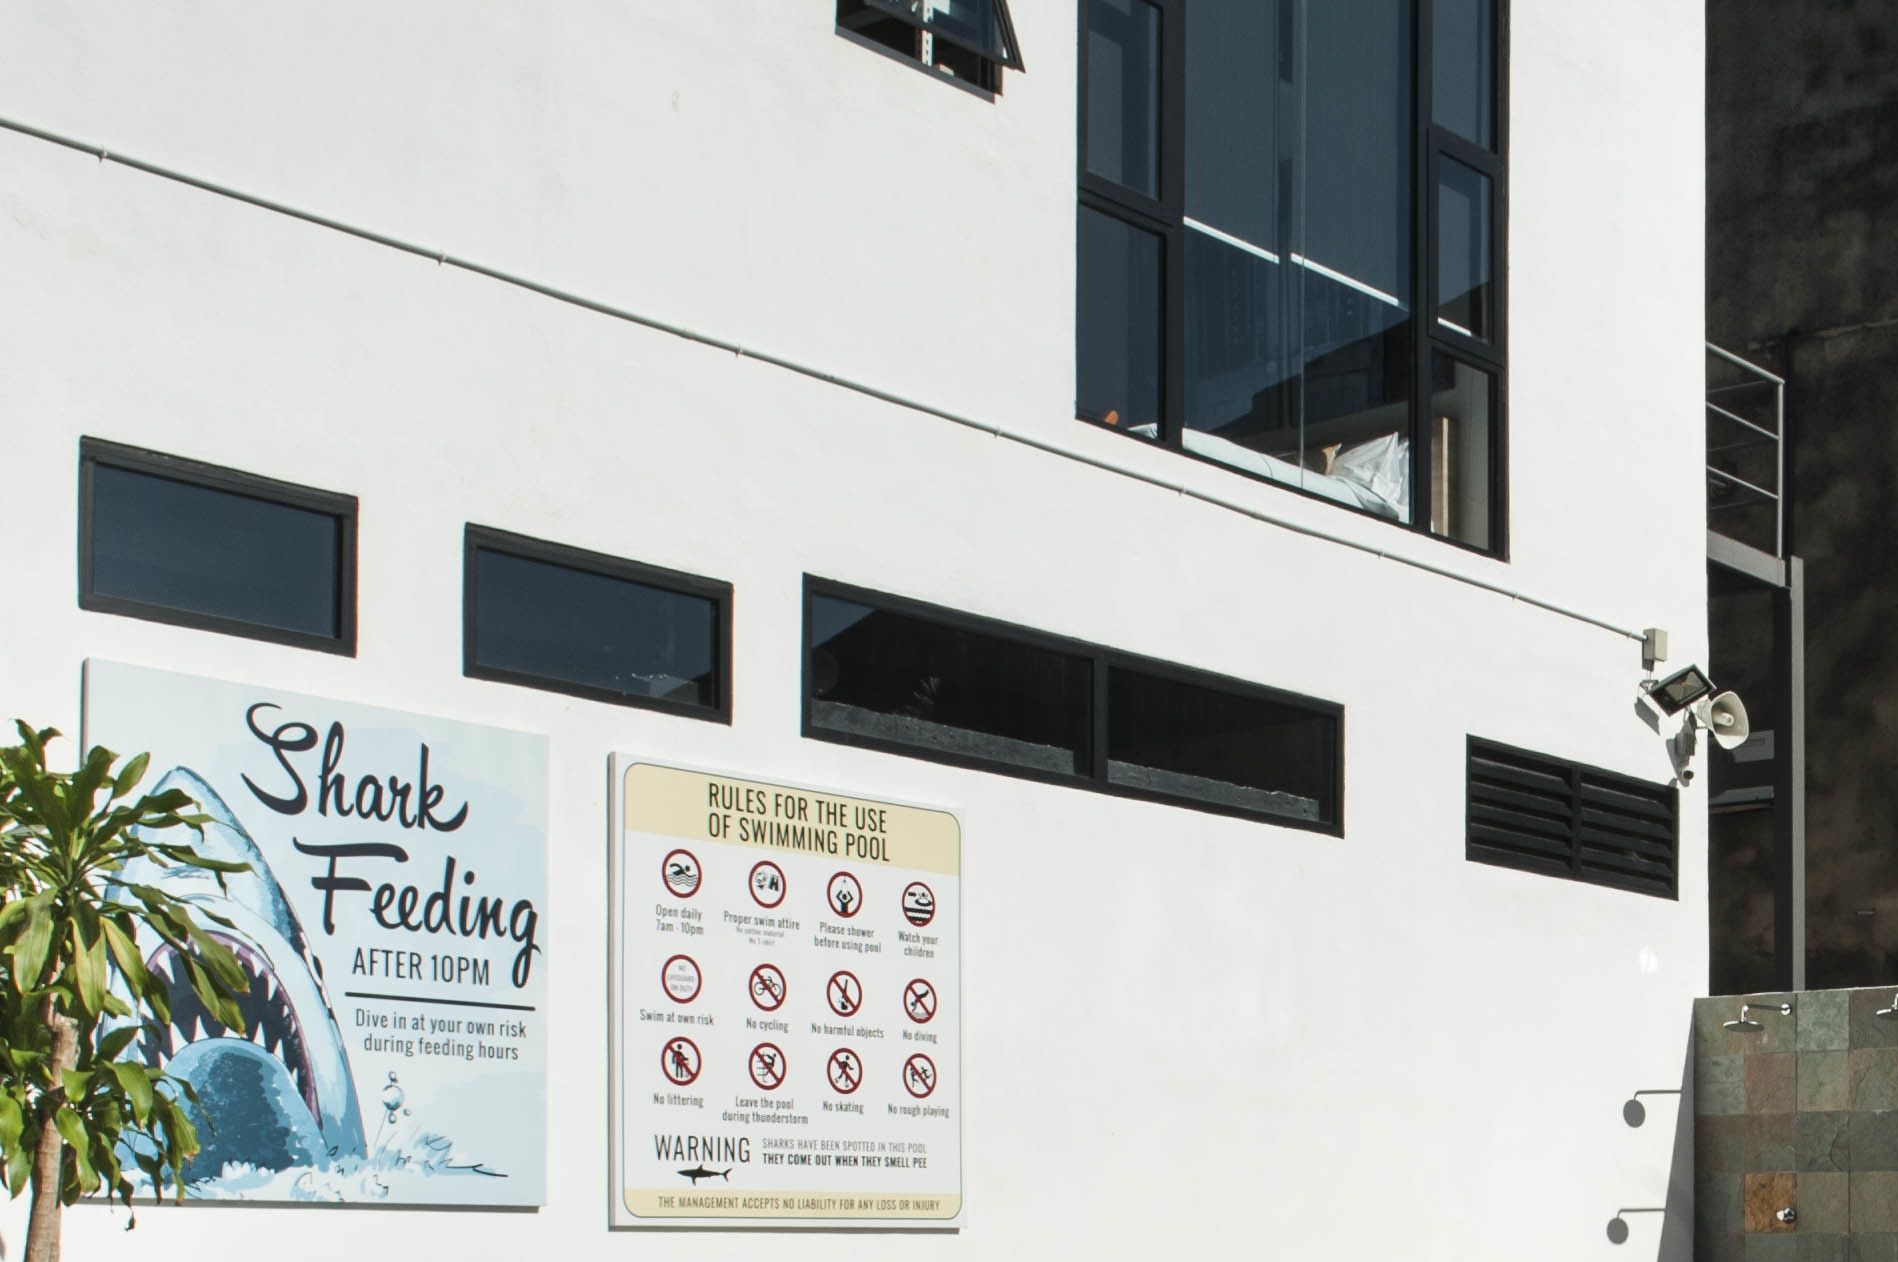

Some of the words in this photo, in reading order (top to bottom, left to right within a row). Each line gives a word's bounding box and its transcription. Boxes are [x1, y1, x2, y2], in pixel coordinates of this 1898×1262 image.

[241, 703, 468, 832] Shark
[709, 783, 767, 815] RULES
[775, 793, 808, 822] FOR
[816, 800, 848, 827] THE
[855, 806, 887, 833] USE
[709, 813, 732, 839] OF
[739, 817, 838, 854] SWIMMING
[846, 833, 890, 862] POOL
[293, 837, 542, 988] Feeding
[656, 904, 678, 918] Open
[681, 907, 702, 922] daily
[723, 910, 751, 925] Proper
[754, 916, 775, 927] swim
[777, 917, 800, 930] attire
[656, 919, 674, 932] 7am
[681, 921, 704, 936] 10pm
[819, 921, 845, 935] Please
[848, 925, 875, 938] shower
[814, 936, 839, 949] before
[841, 941, 863, 953] using
[864, 943, 881, 954] pool
[898, 930, 920, 943] Watch
[922, 936, 939, 946] your
[904, 946, 934, 959] children
[352, 947, 422, 980] AFTER
[431, 954, 489, 986] 10PM
[355, 1008, 388, 1028] Dive
[393, 1012, 407, 1029] in
[411, 1014, 426, 1031] at
[430, 1018, 463, 1036] your
[467, 1021, 495, 1036] own
[500, 1020, 527, 1038] risk
[640, 1009, 664, 1022] Swim
[666, 1012, 675, 1023] at
[677, 1014, 695, 1025] own
[697, 1013, 714, 1026] risk
[746, 1017, 757, 1029] No
[759, 1019, 789, 1034] cycling
[811, 1023, 821, 1034] No
[823, 1024, 855, 1036] harmful
[856, 1026, 884, 1039] objects
[902, 1030, 912, 1040] No
[914, 1031, 937, 1044] diving
[364, 1033, 414, 1057] during
[418, 1037, 474, 1061] feeding
[478, 1041, 519, 1060] hours
[653, 1093, 665, 1105] No
[667, 1094, 704, 1108] littering
[735, 1096, 758, 1108] Leave
[760, 1097, 773, 1109] the
[776, 1098, 793, 1111] pool
[823, 1101, 833, 1112] No
[835, 1101, 864, 1115] skating
[722, 1110, 750, 1124] during
[752, 1111, 808, 1125] thunderstorm
[888, 1104, 898, 1114] No
[899, 1105, 920, 1117] rough
[922, 1105, 949, 1119] playing
[654, 1134, 751, 1163] WARNING
[762, 1137, 795, 1150] SHARKS
[798, 1138, 819, 1151] HAVE
[821, 1139, 840, 1151] BEEN
[843, 1140, 876, 1153] SPOTTED
[878, 1142, 886, 1153] IN
[888, 1142, 905, 1153] THIS
[908, 1143, 927, 1154] POOL
[763, 1152, 784, 1165] THEY
[788, 1153, 812, 1166] COME
[815, 1154, 832, 1166] OUT
[835, 1155, 858, 1167] WHEN
[861, 1155, 881, 1167] THEY
[885, 1156, 910, 1168] SMELL
[913, 1157, 927, 1169] PEE
[658, 1196, 675, 1208] THE
[679, 1196, 739, 1209] MANAGEMENT
[742, 1197, 780, 1209] ACCEPTS
[783, 1198, 794, 1209] NO
[798, 1198, 837, 1210] LIABILITY
[840, 1199, 854, 1210] FOR
[858, 1199, 873, 1210] ANY
[876, 1199, 897, 1210] LOSS
[900, 1199, 909, 1210] OR
[912, 1199, 940, 1211] INJURY
